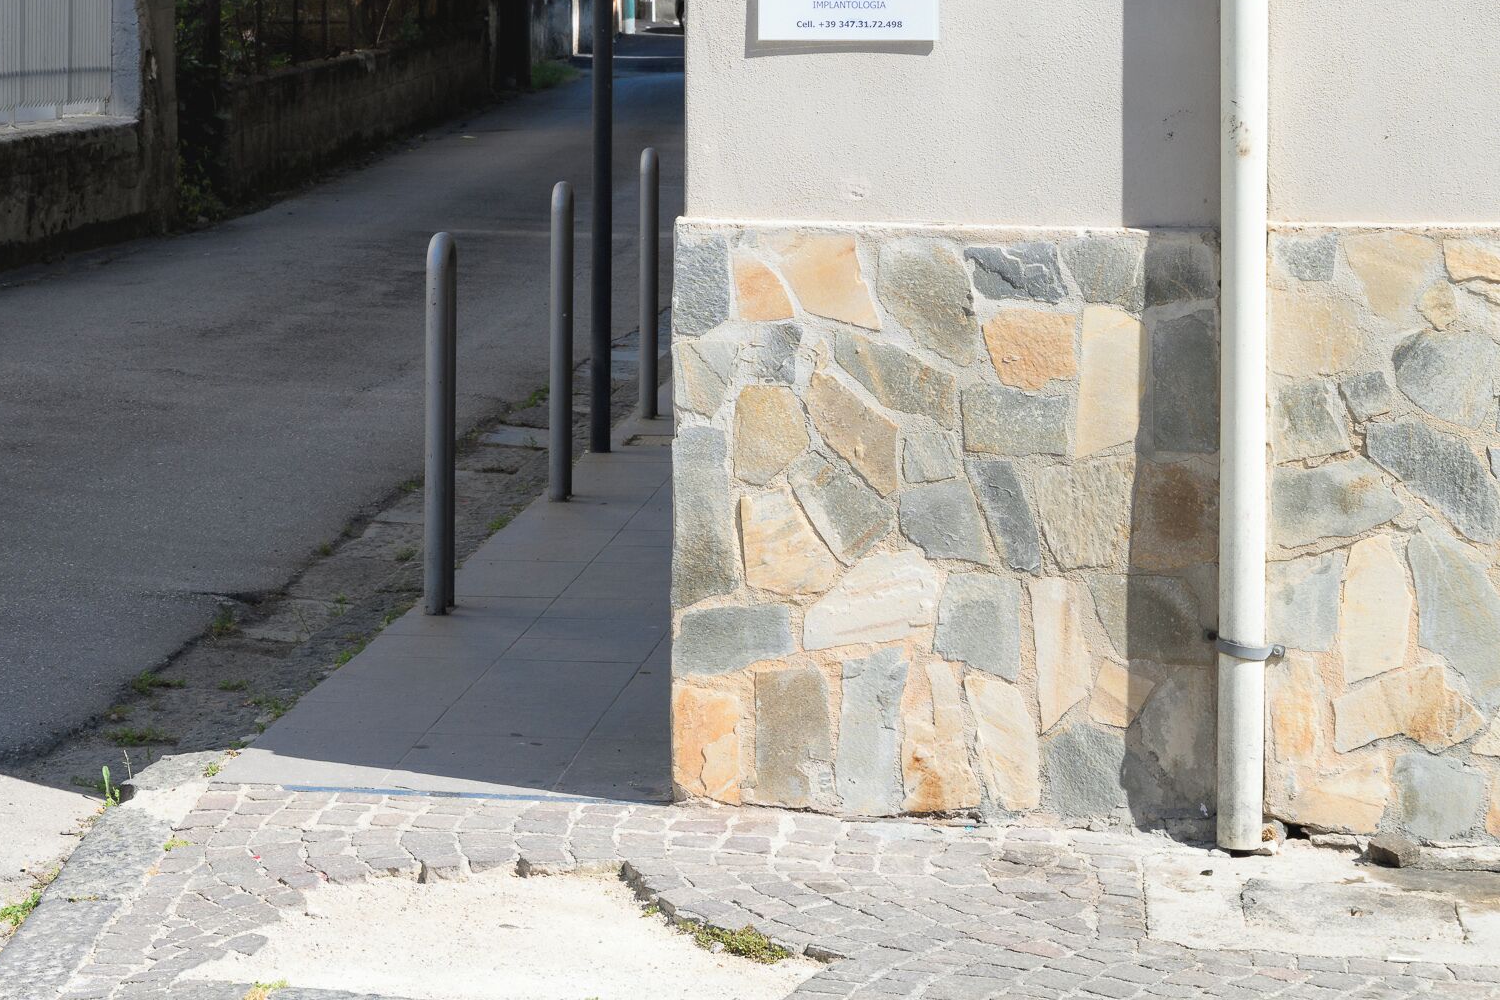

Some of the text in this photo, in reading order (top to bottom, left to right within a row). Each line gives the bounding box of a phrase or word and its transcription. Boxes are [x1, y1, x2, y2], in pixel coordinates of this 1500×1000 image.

[812, 1, 887, 9] IMPLANTOLOGIA
[796, 20, 903, 28] Cell. +39 347.31.72.498
